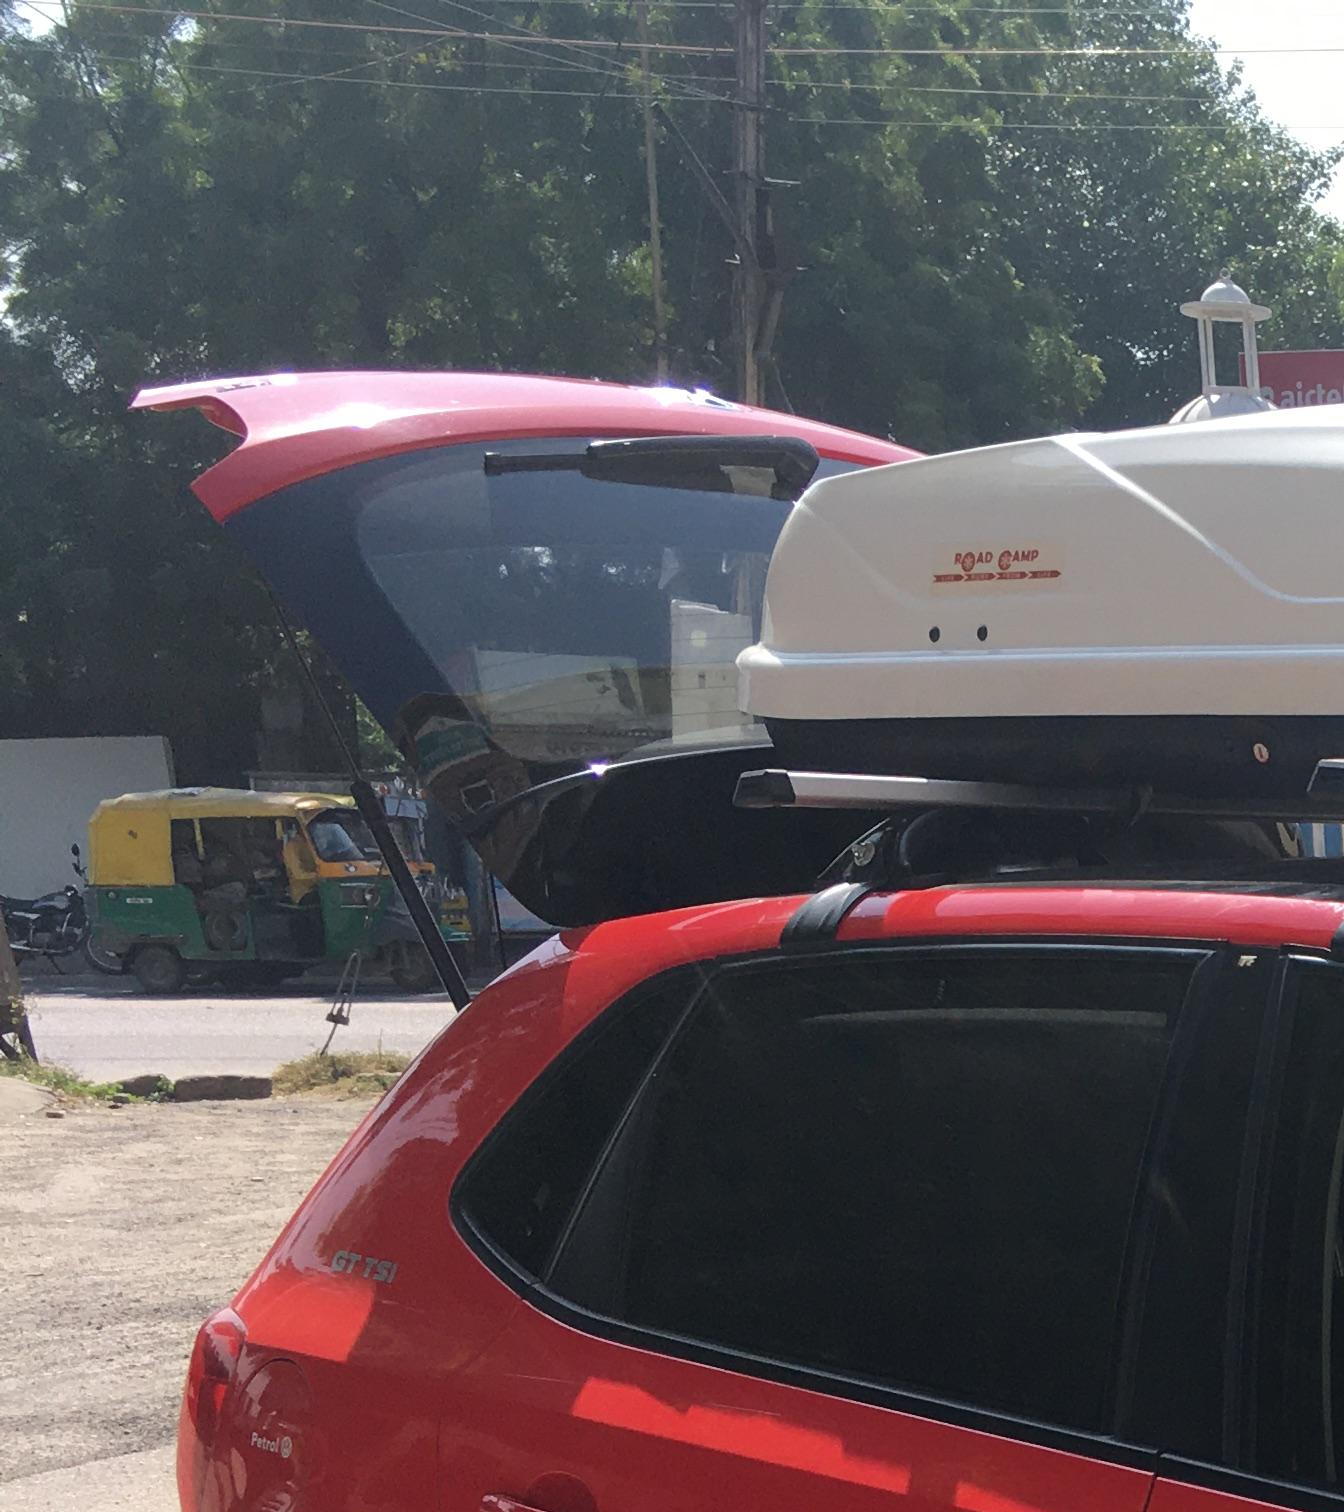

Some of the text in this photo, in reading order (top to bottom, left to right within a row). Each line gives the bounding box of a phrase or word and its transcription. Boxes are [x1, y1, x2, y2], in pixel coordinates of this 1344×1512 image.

[954, 549, 1039, 572] ROAD CAMP
[331, 1249, 399, 1284] GT TSI
[250, 1431, 280, 1453] Petrol
